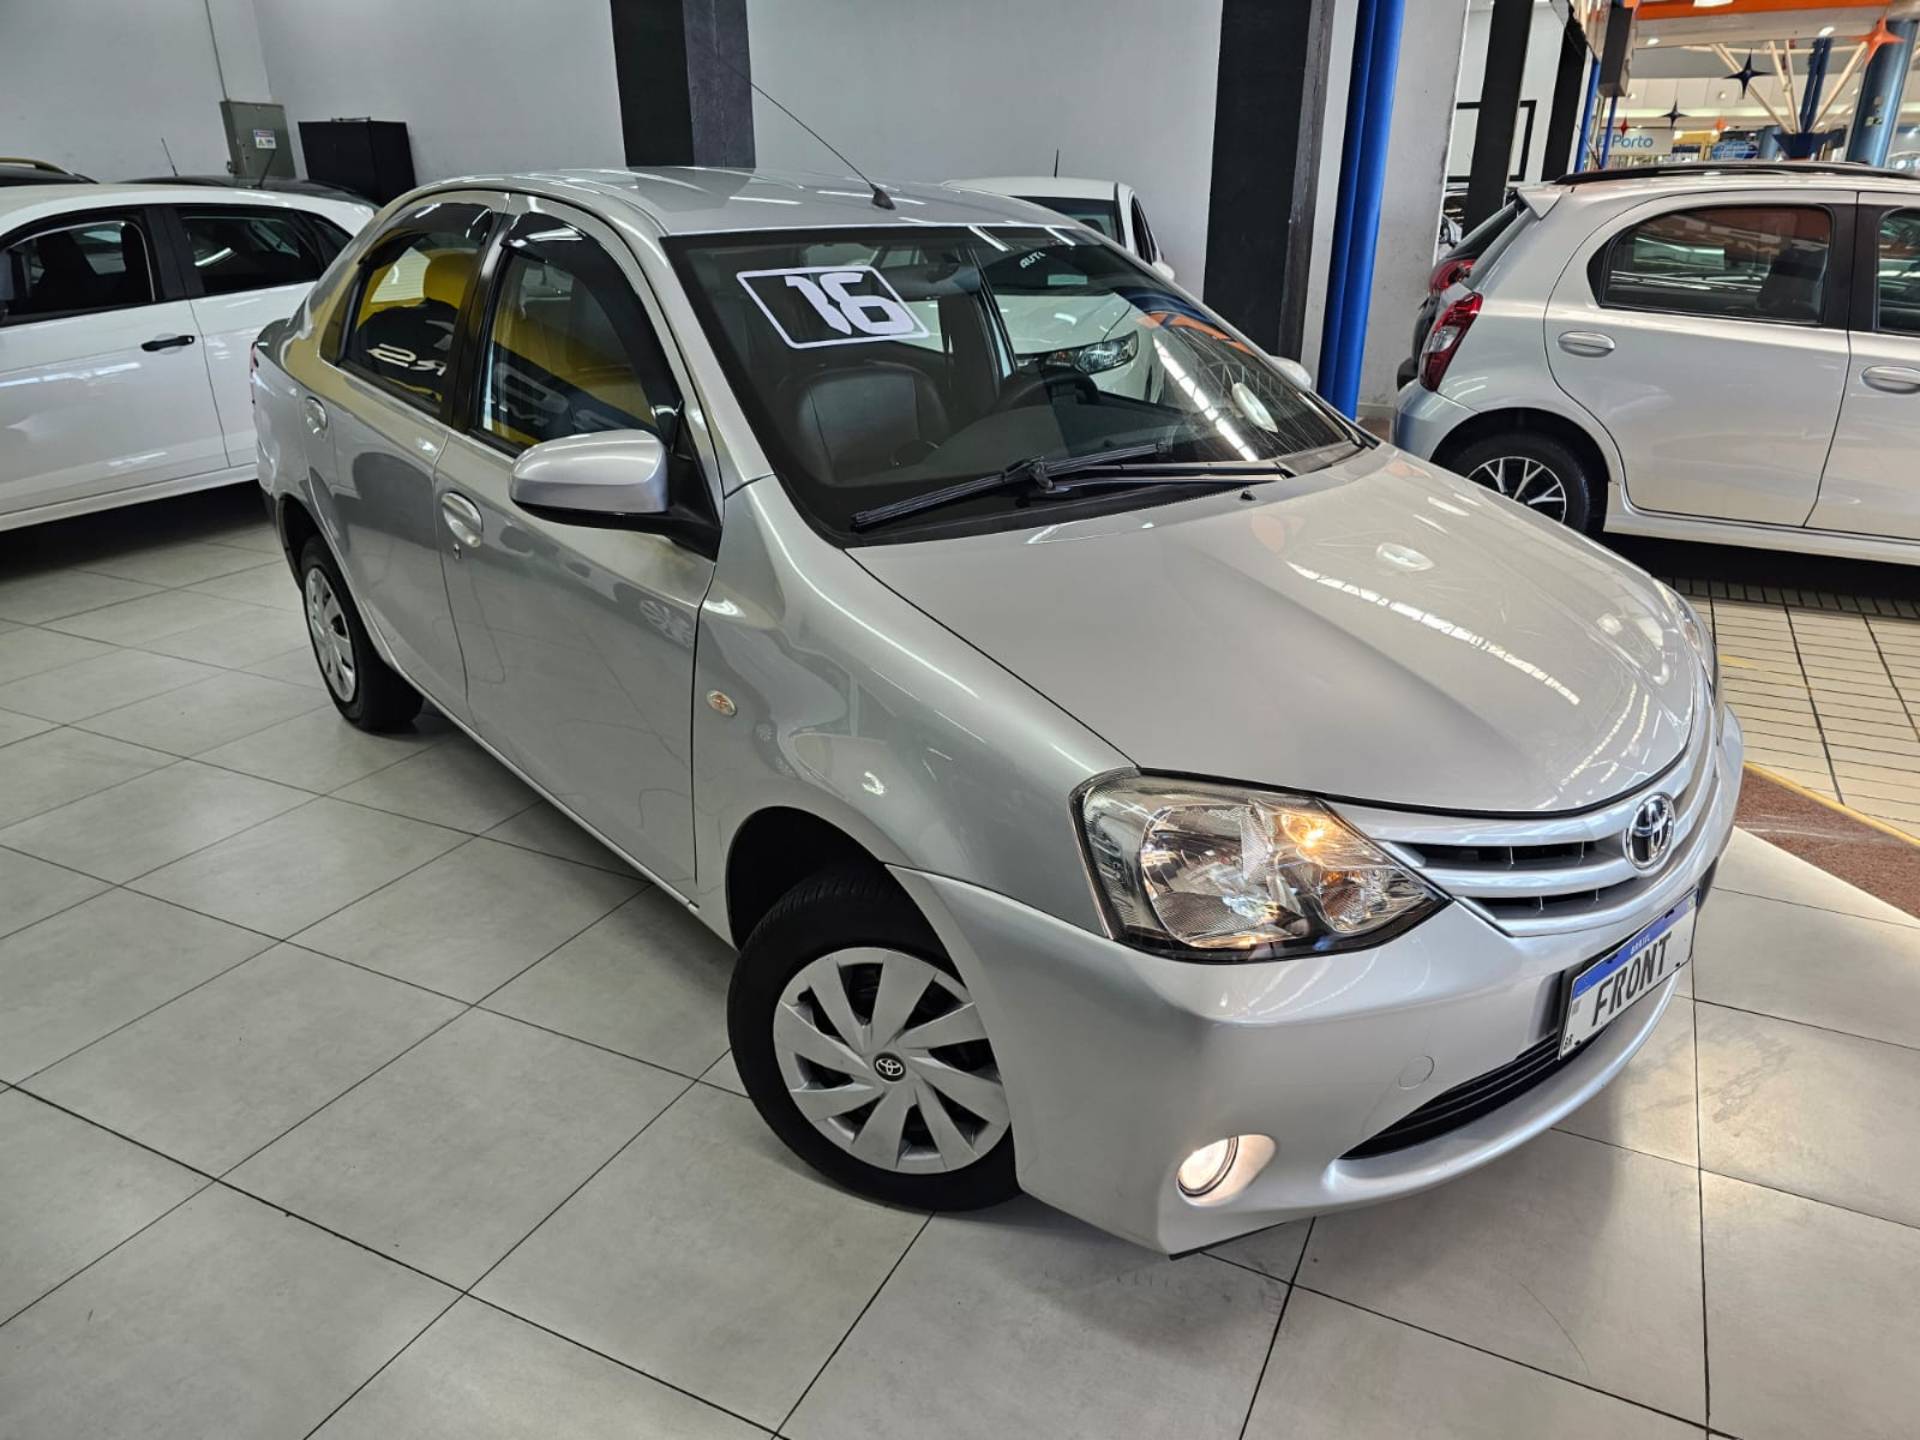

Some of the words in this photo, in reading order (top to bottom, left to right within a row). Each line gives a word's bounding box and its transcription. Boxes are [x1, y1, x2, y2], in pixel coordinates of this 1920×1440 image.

[1612, 136, 1654, 148] Porto
[784, 272, 914, 335] 16
[1591, 931, 1672, 1027] FRONT
